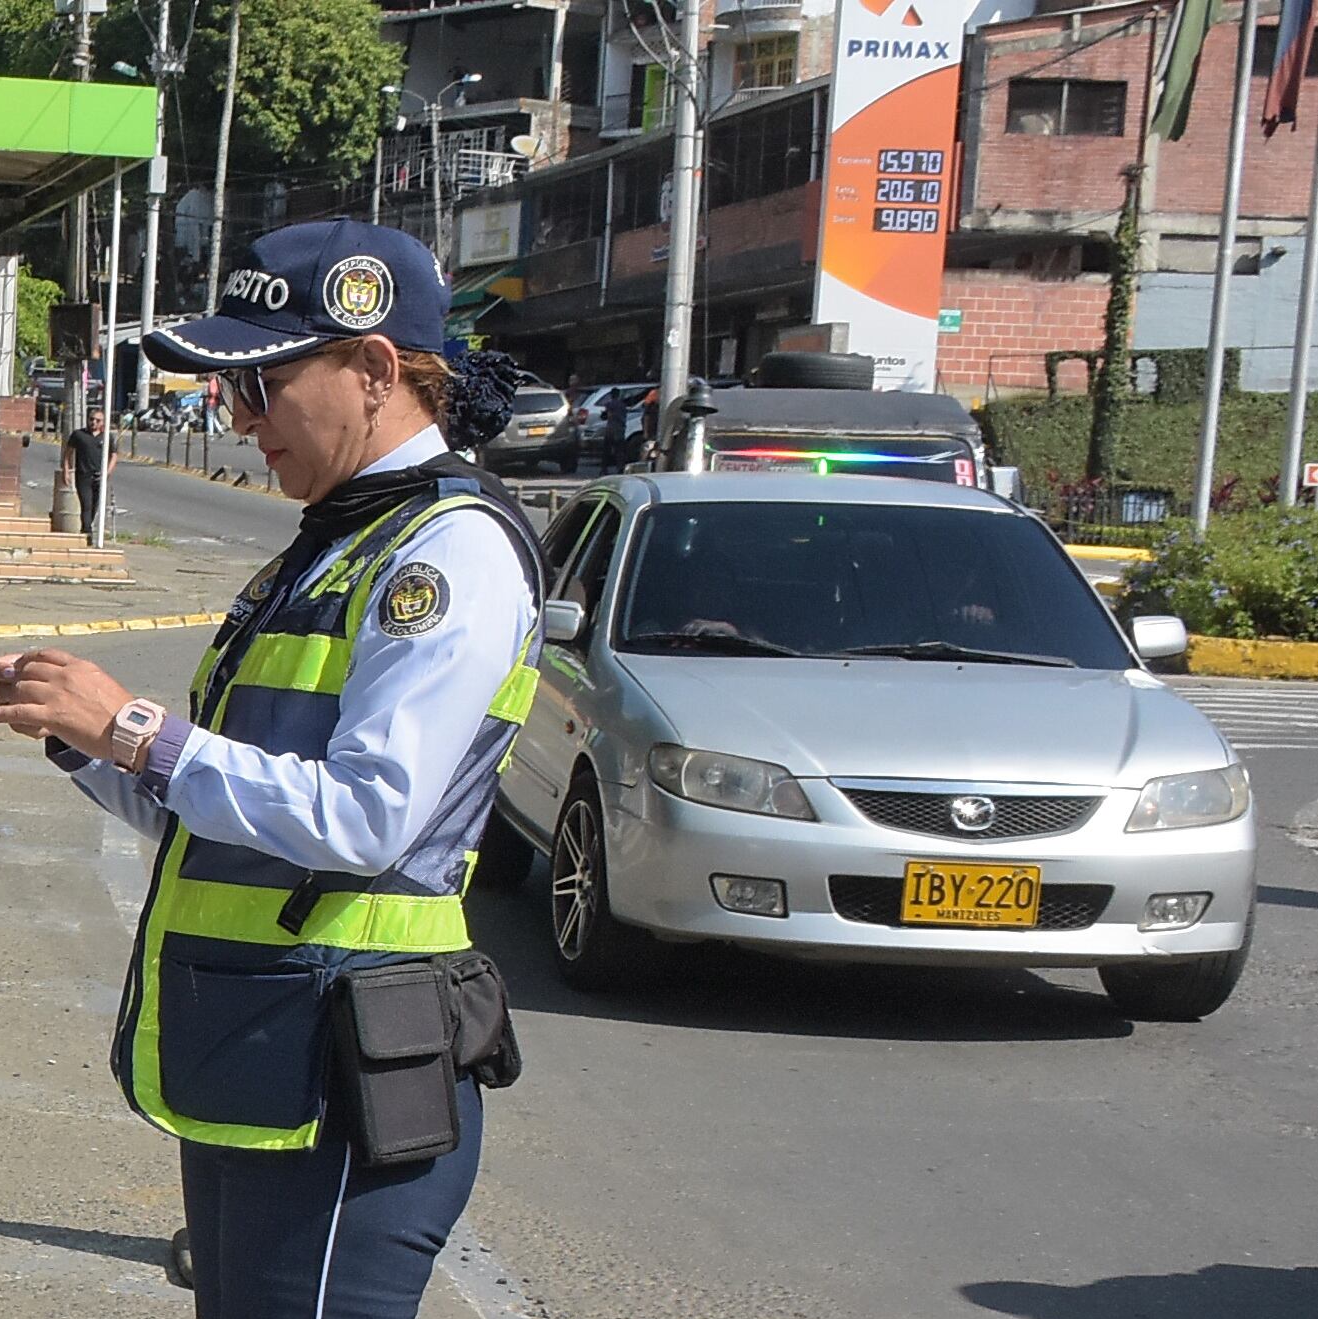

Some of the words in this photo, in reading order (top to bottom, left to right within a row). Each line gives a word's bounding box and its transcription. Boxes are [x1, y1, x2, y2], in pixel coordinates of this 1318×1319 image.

[847, 39, 950, 59] PRIMAX
[909, 872, 968, 907] IBY
[974, 874, 1034, 910] 220
[936, 908, 1002, 922] MANIZALES
